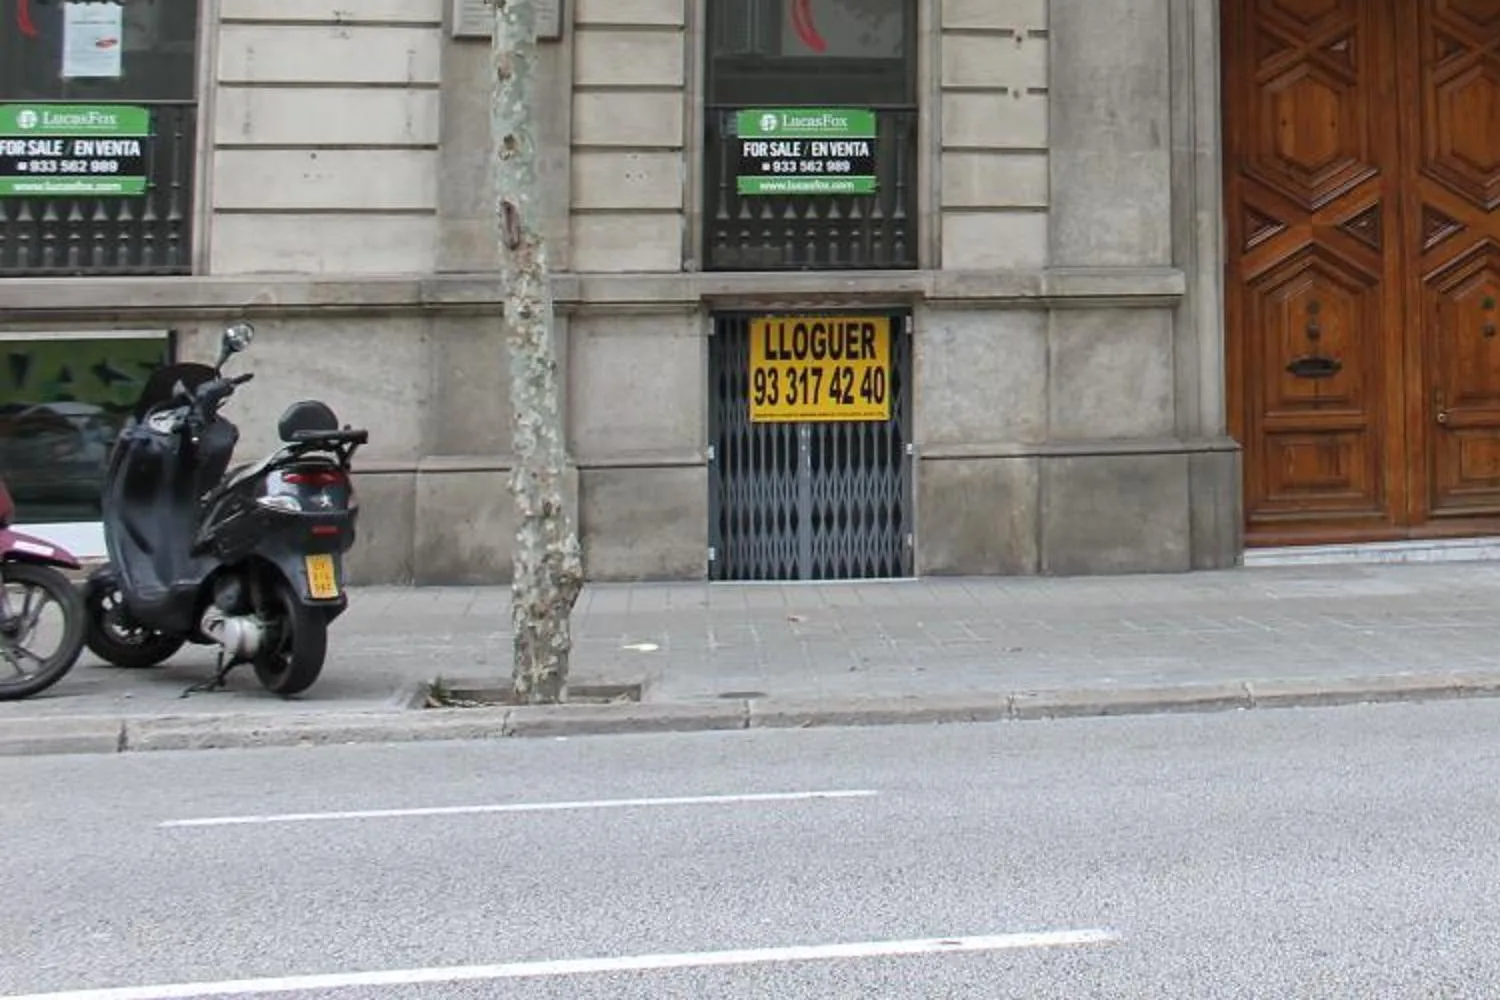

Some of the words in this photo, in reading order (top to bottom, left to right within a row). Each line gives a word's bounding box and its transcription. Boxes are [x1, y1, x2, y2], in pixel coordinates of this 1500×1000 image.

[43, 111, 118, 125] LucasFox
[783, 114, 848, 127] LucasFox
[0, 140, 26, 156] FOR
[27, 140, 63, 156] SALE
[74, 140, 94, 156] EN
[95, 140, 140, 157] VENTA
[743, 142, 768, 157] FOR
[769, 142, 801, 157] SALE
[811, 142, 828, 157] EN
[829, 142, 869, 157] VENTA
[772, 160, 797, 172] 933
[764, 322, 876, 361] LLOGUER
[754, 366, 779, 406] 93
[785, 366, 824, 406] 317
[829, 365, 855, 405] 42
[860, 365, 886, 405] 40
